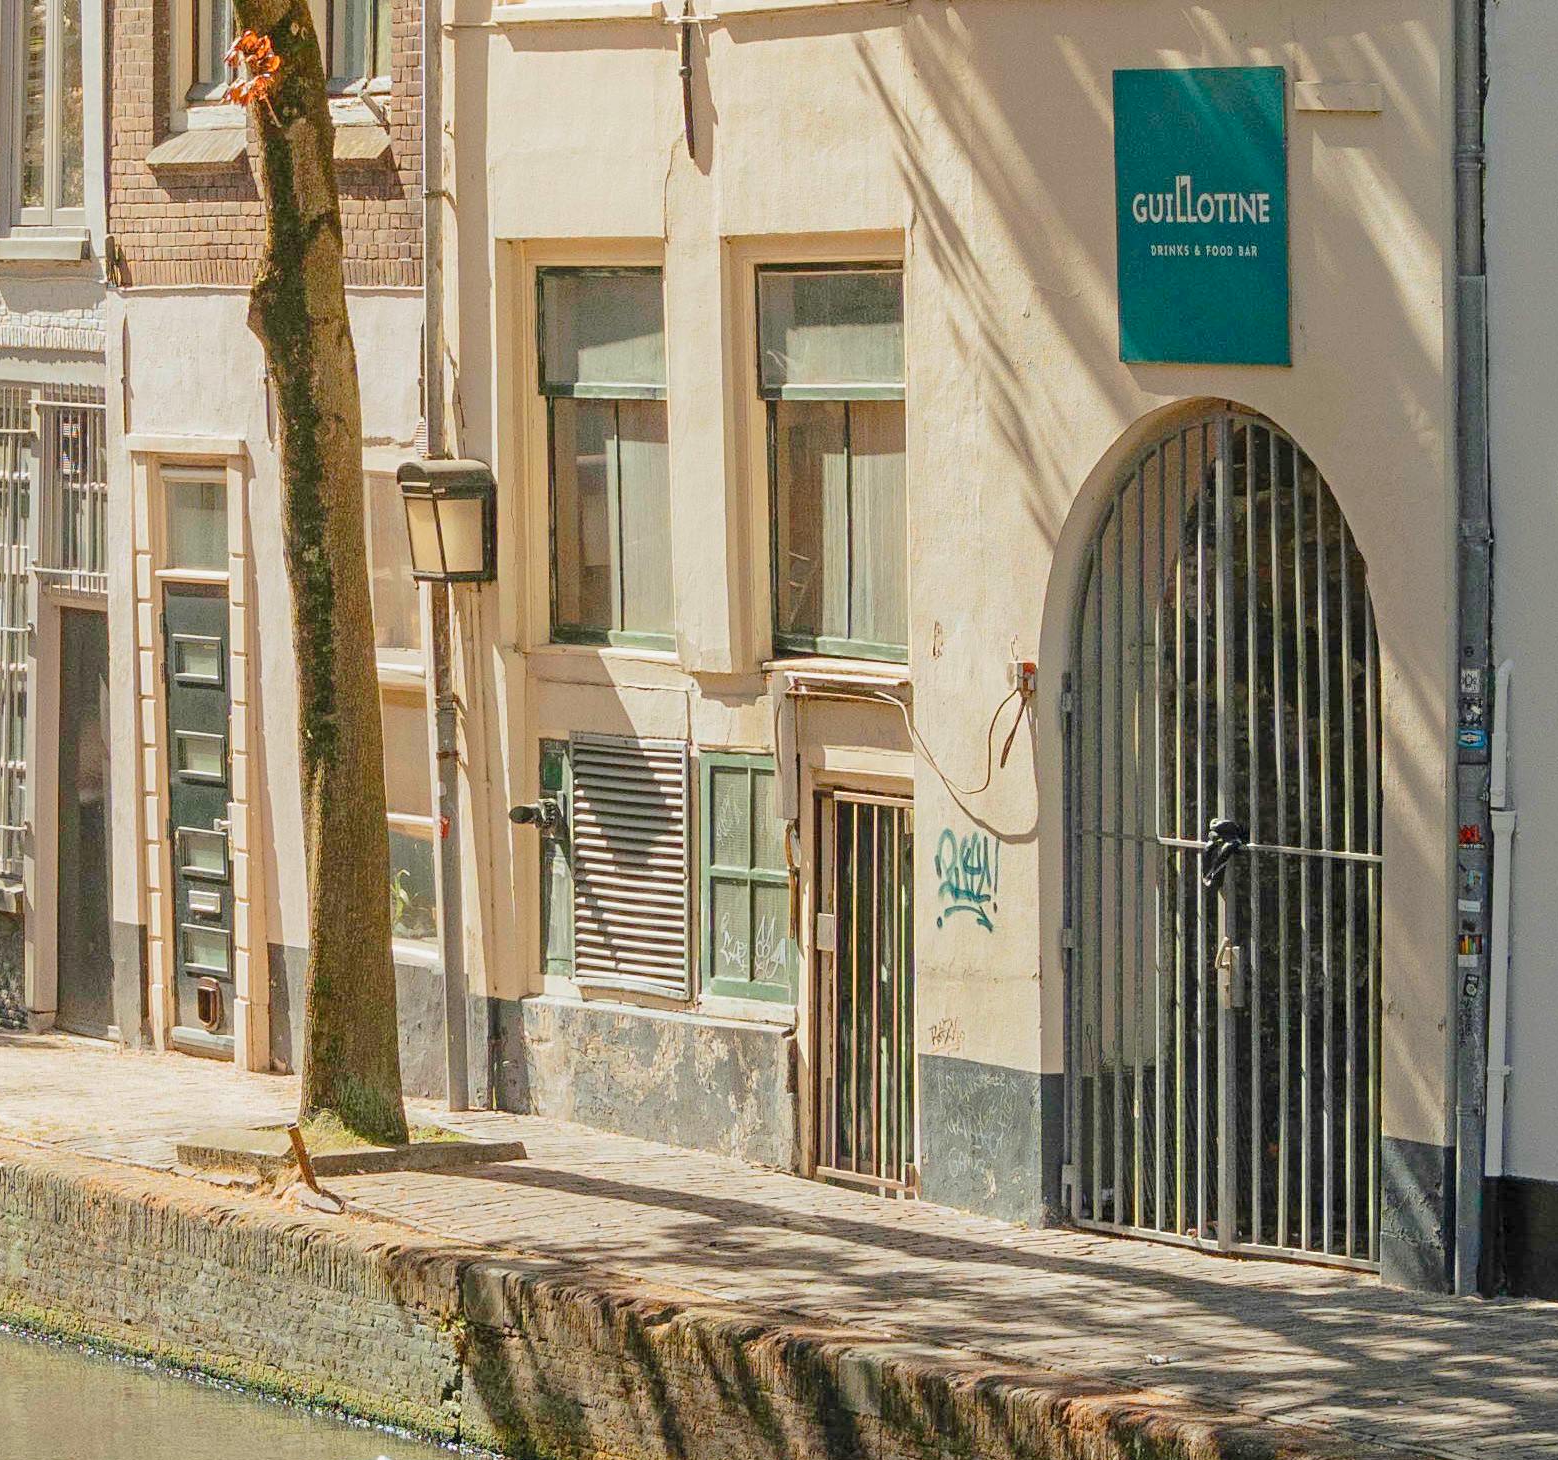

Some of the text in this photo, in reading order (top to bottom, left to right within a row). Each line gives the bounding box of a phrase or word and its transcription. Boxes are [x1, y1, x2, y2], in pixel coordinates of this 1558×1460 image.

[1132, 174, 1271, 225] GUILLOTINE
[1150, 244, 1259, 257] DRINKS & FOOD BAR
